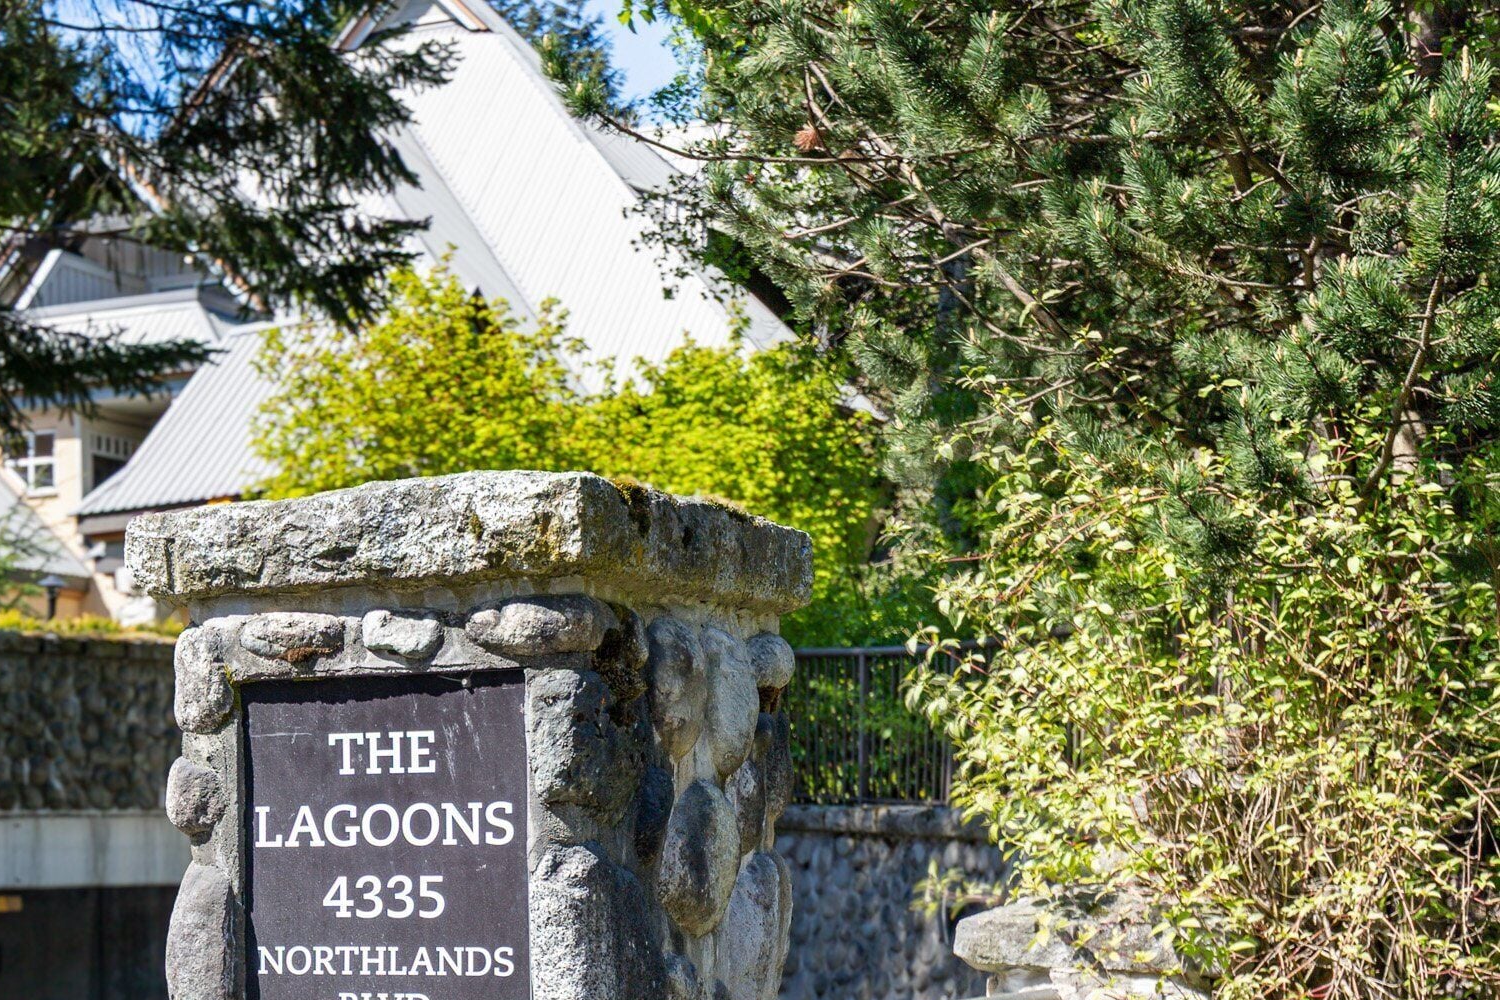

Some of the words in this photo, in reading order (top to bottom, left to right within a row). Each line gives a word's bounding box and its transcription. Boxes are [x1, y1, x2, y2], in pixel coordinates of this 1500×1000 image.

[327, 730, 437, 776] THE
[254, 800, 515, 849] LAGOONS
[322, 874, 446, 919] 4335
[257, 944, 515, 978] NORTHLANDS
